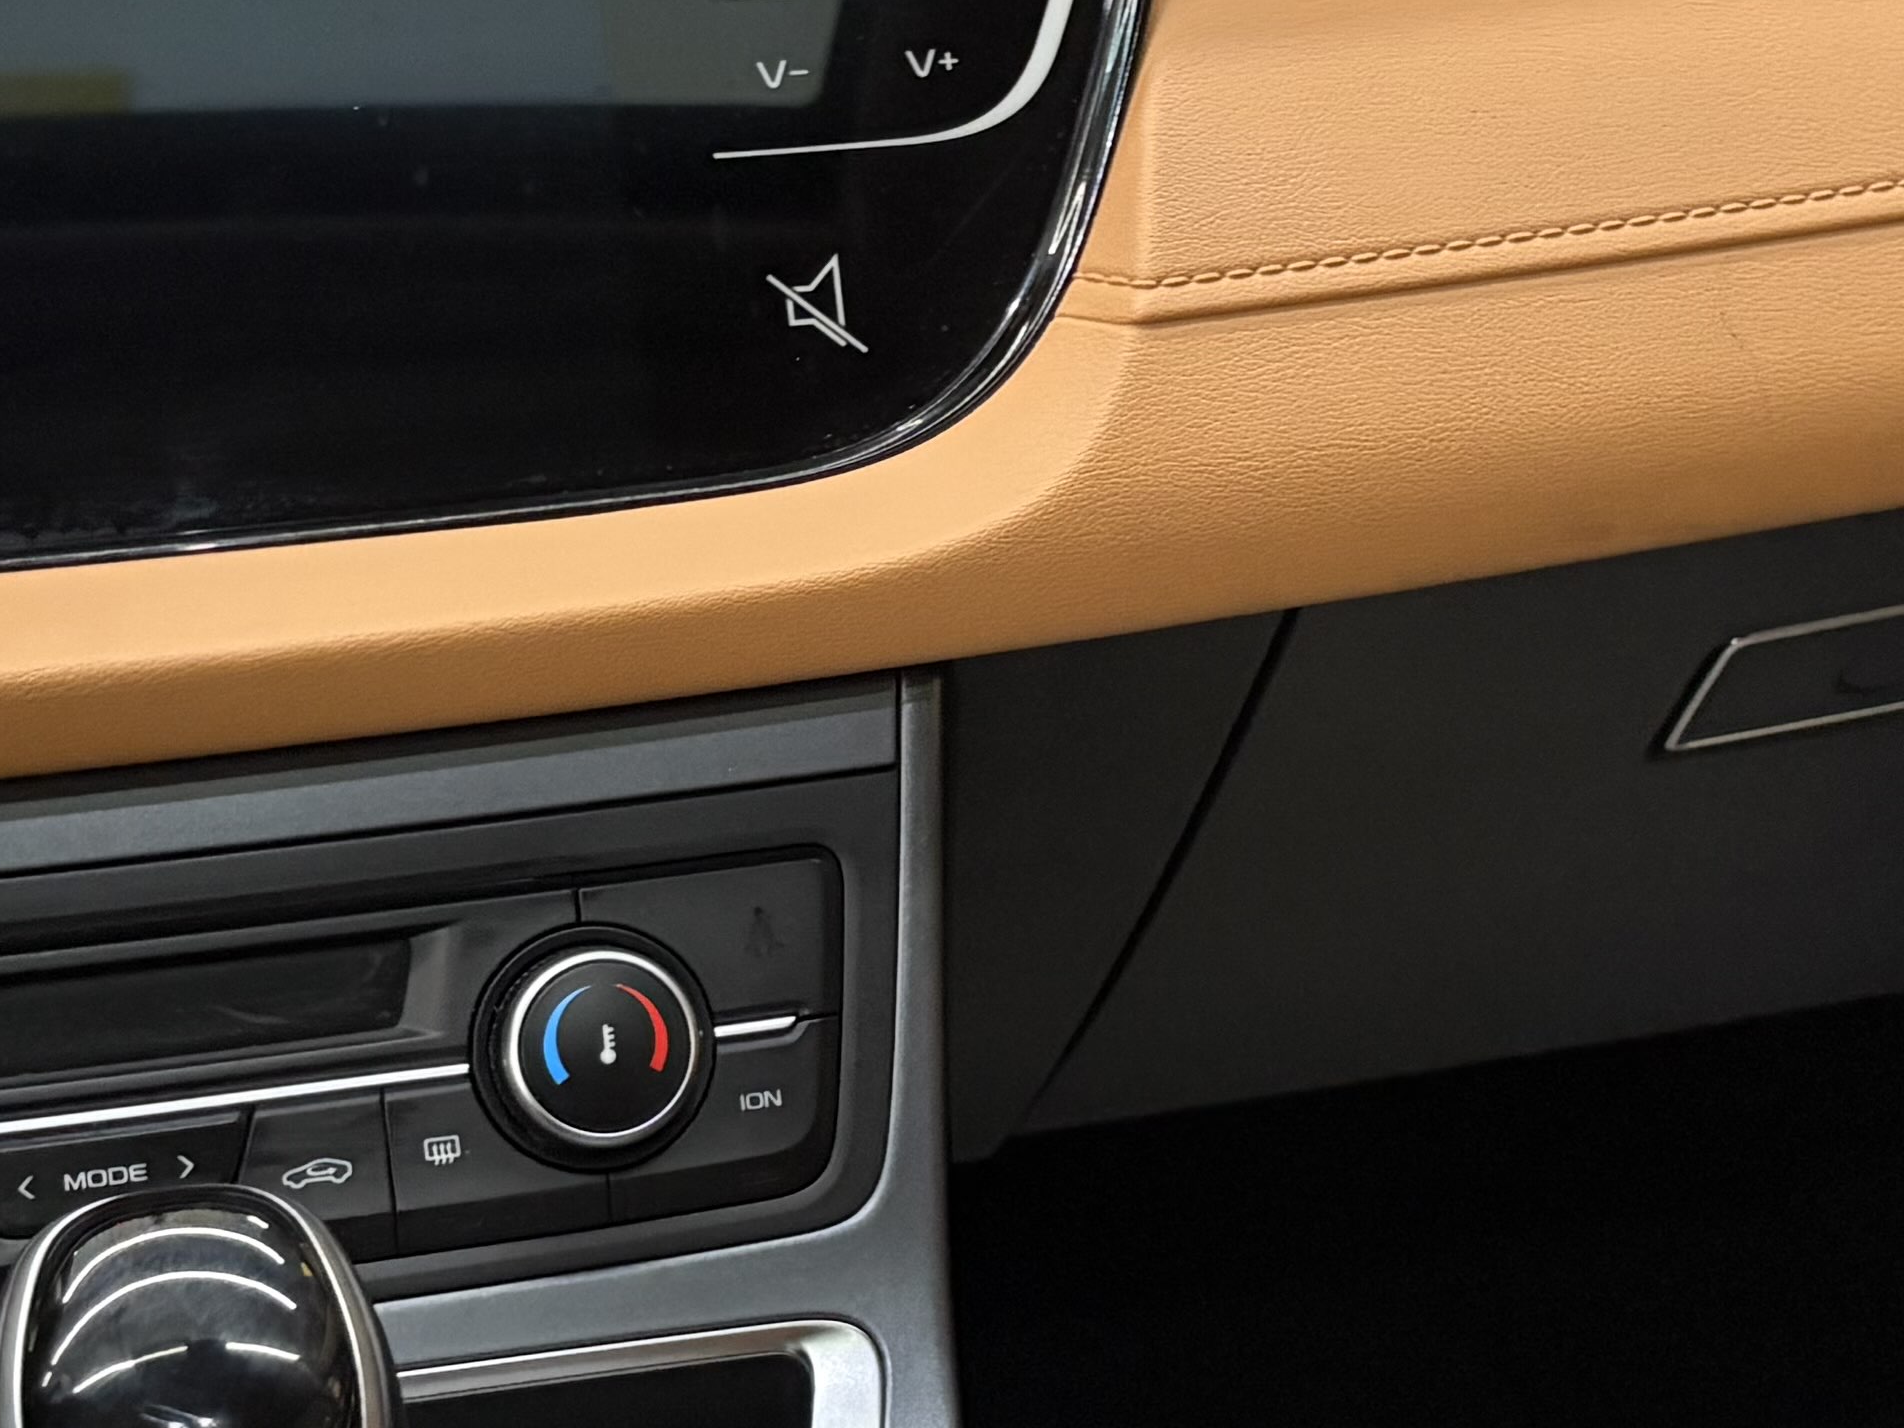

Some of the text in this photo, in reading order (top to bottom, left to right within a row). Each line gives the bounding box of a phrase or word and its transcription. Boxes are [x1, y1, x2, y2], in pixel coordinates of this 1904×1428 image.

[756, 59, 809, 89] V-
[904, 48, 959, 78] V+
[739, 1089, 783, 1111] ION
[63, 1163, 148, 1191] MODE
